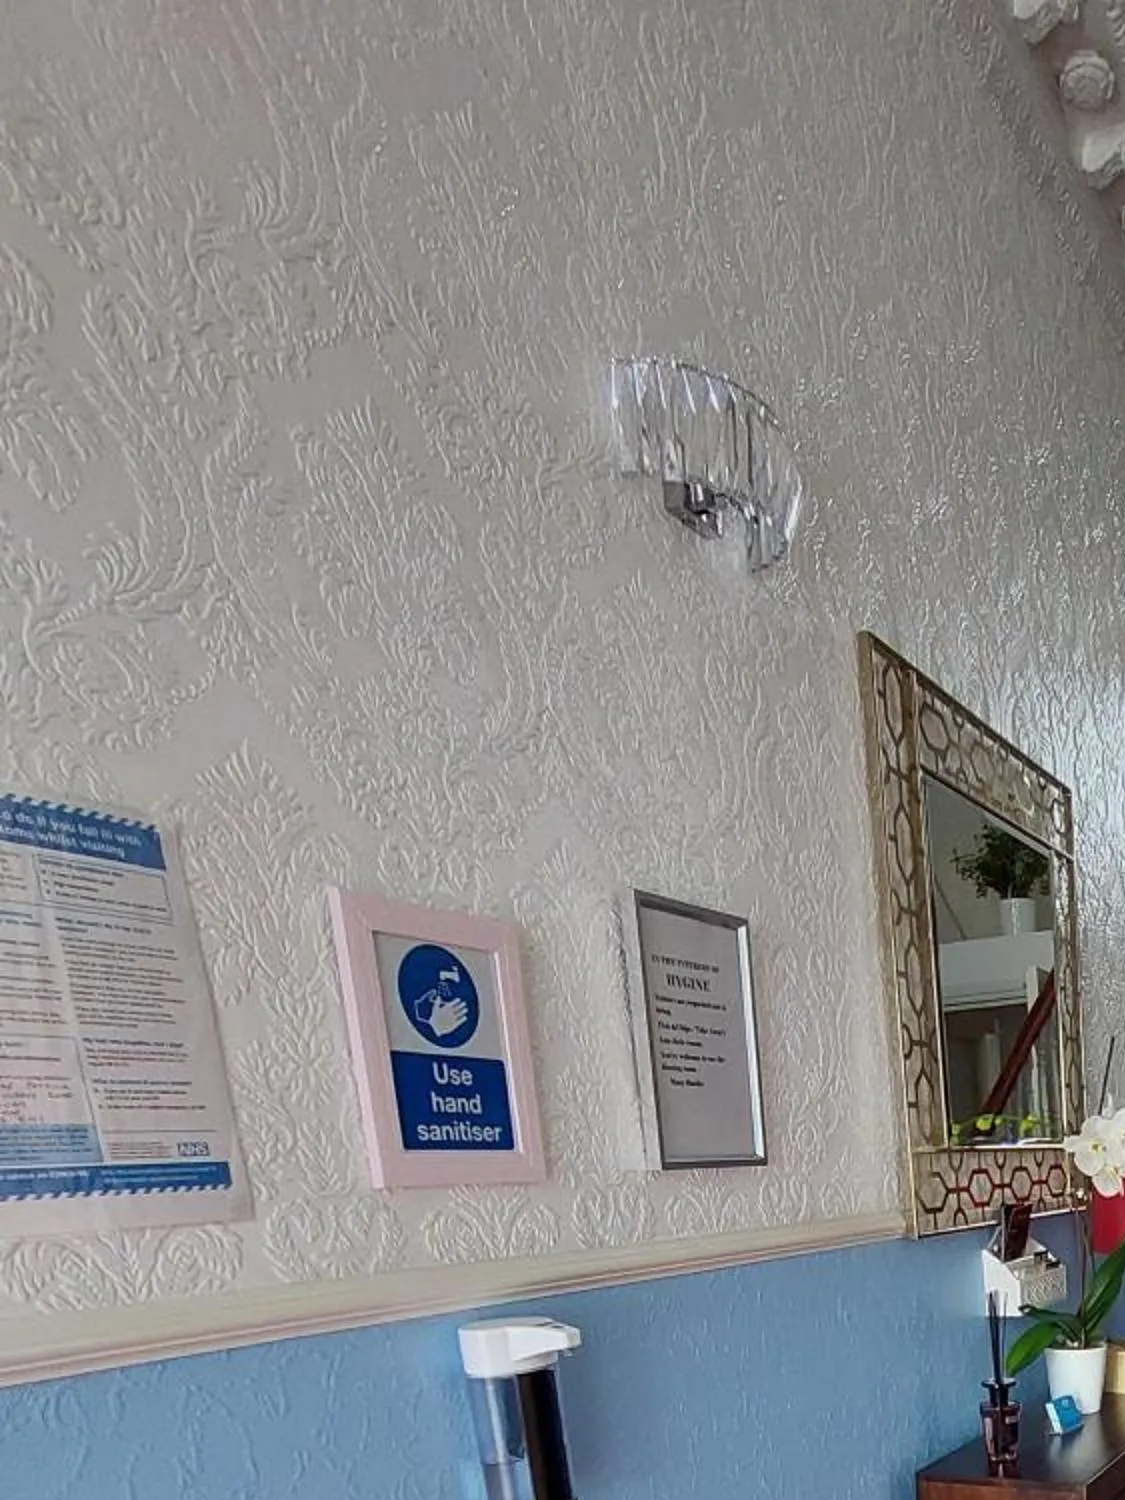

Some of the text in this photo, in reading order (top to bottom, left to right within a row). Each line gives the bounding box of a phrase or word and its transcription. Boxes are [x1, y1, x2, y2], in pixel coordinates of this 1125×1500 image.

[432, 1061, 474, 1087] Use
[430, 1091, 483, 1115] hand
[416, 1120, 503, 1143] sanitiser
